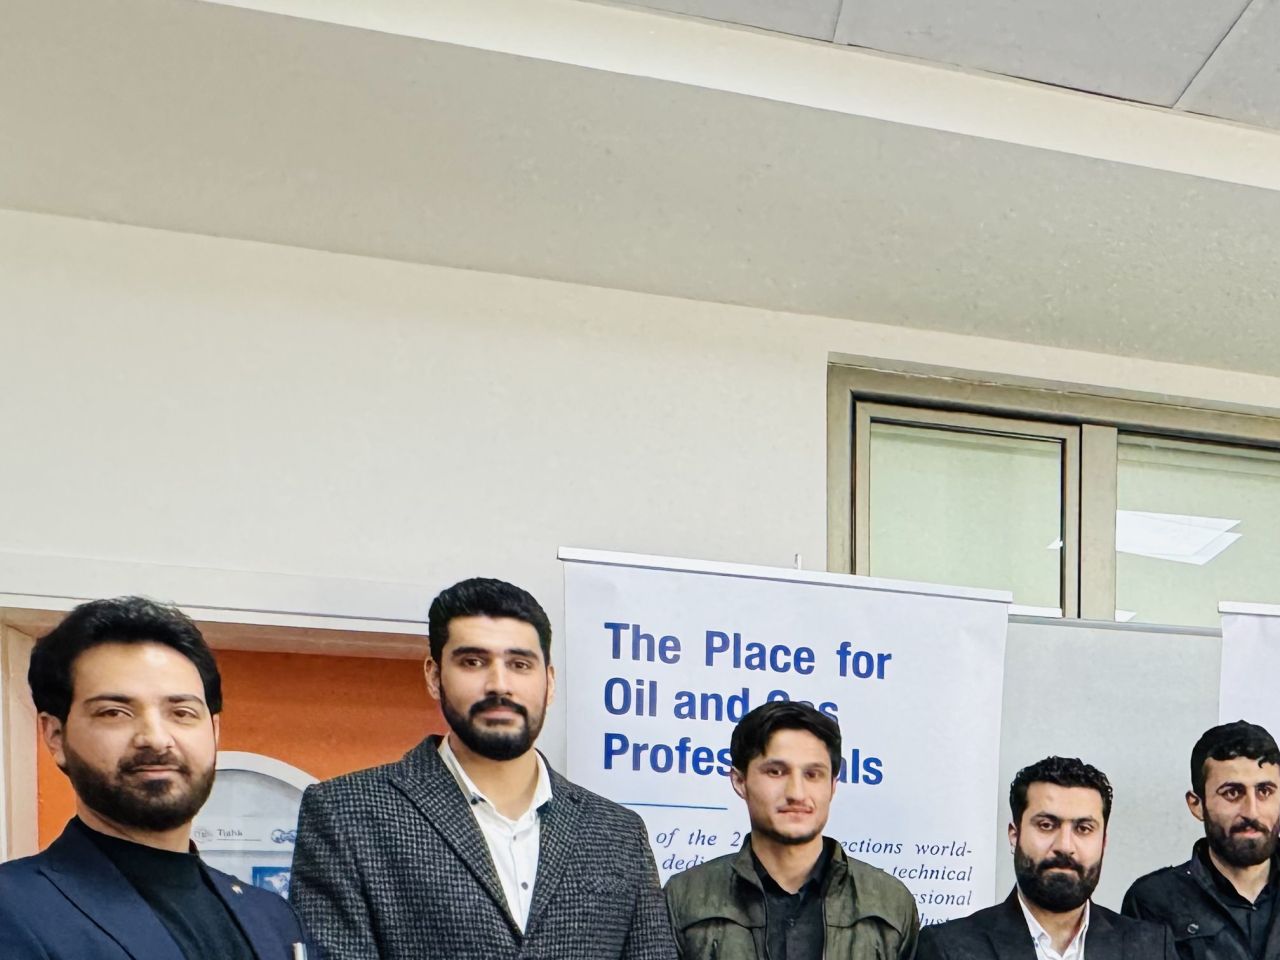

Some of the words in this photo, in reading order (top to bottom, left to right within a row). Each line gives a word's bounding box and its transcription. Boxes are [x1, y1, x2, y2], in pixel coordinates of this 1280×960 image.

[604, 622, 681, 664] The
[705, 630, 815, 675] Place
[836, 641, 893, 680] for
[604, 677, 658, 717] Oil
[673, 687, 750, 724] and
[656, 827, 680, 848] of
[688, 829, 717, 846] the
[915, 840, 972, 857] world-
[892, 864, 973, 882] technical
